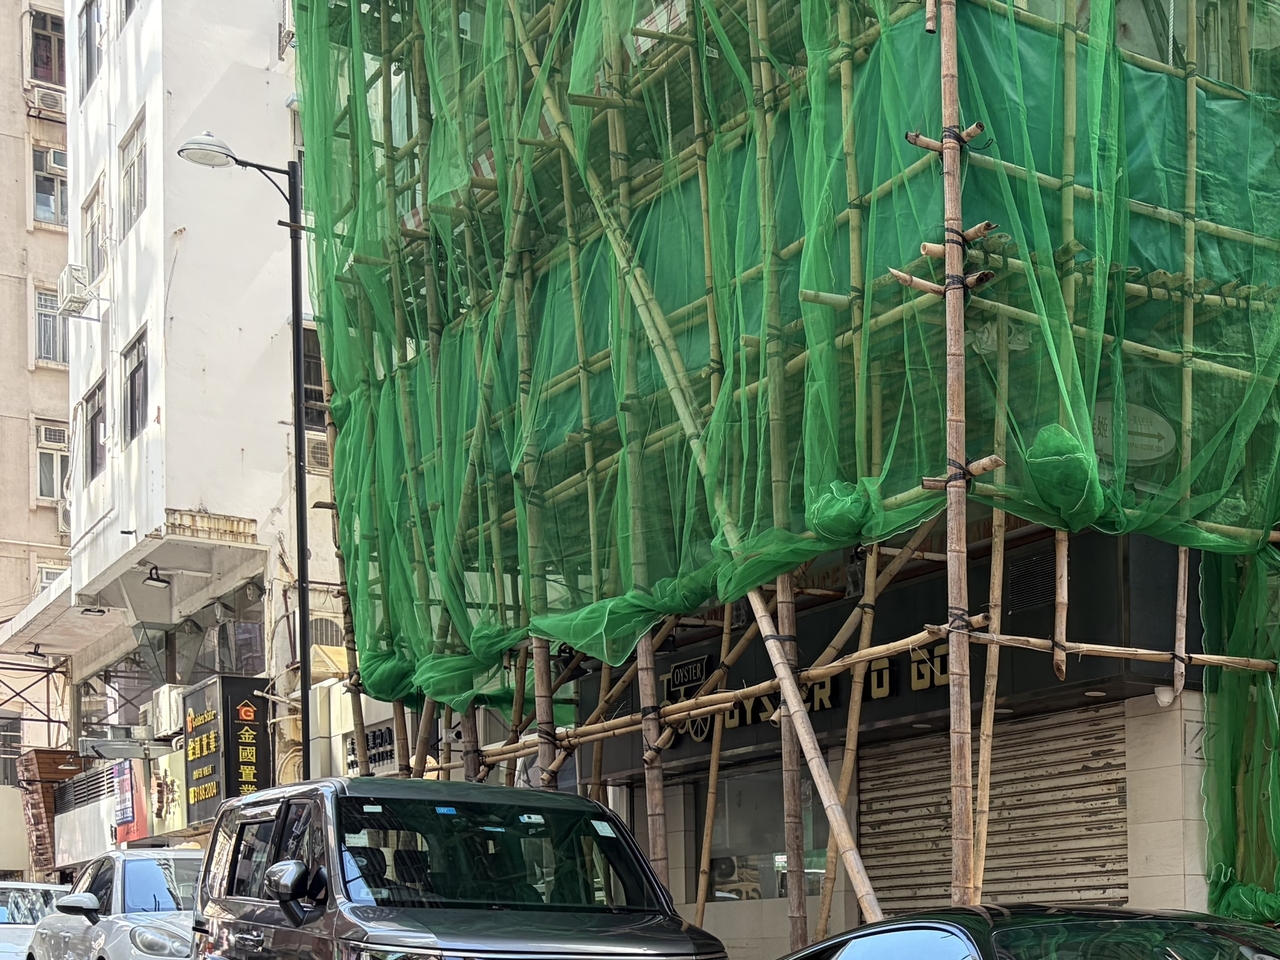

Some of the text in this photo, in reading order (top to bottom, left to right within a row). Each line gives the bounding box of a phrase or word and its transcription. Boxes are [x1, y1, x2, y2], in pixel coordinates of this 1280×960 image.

[674, 662, 702, 685] OYSTER
[237, 725, 258, 797] 金國置業
